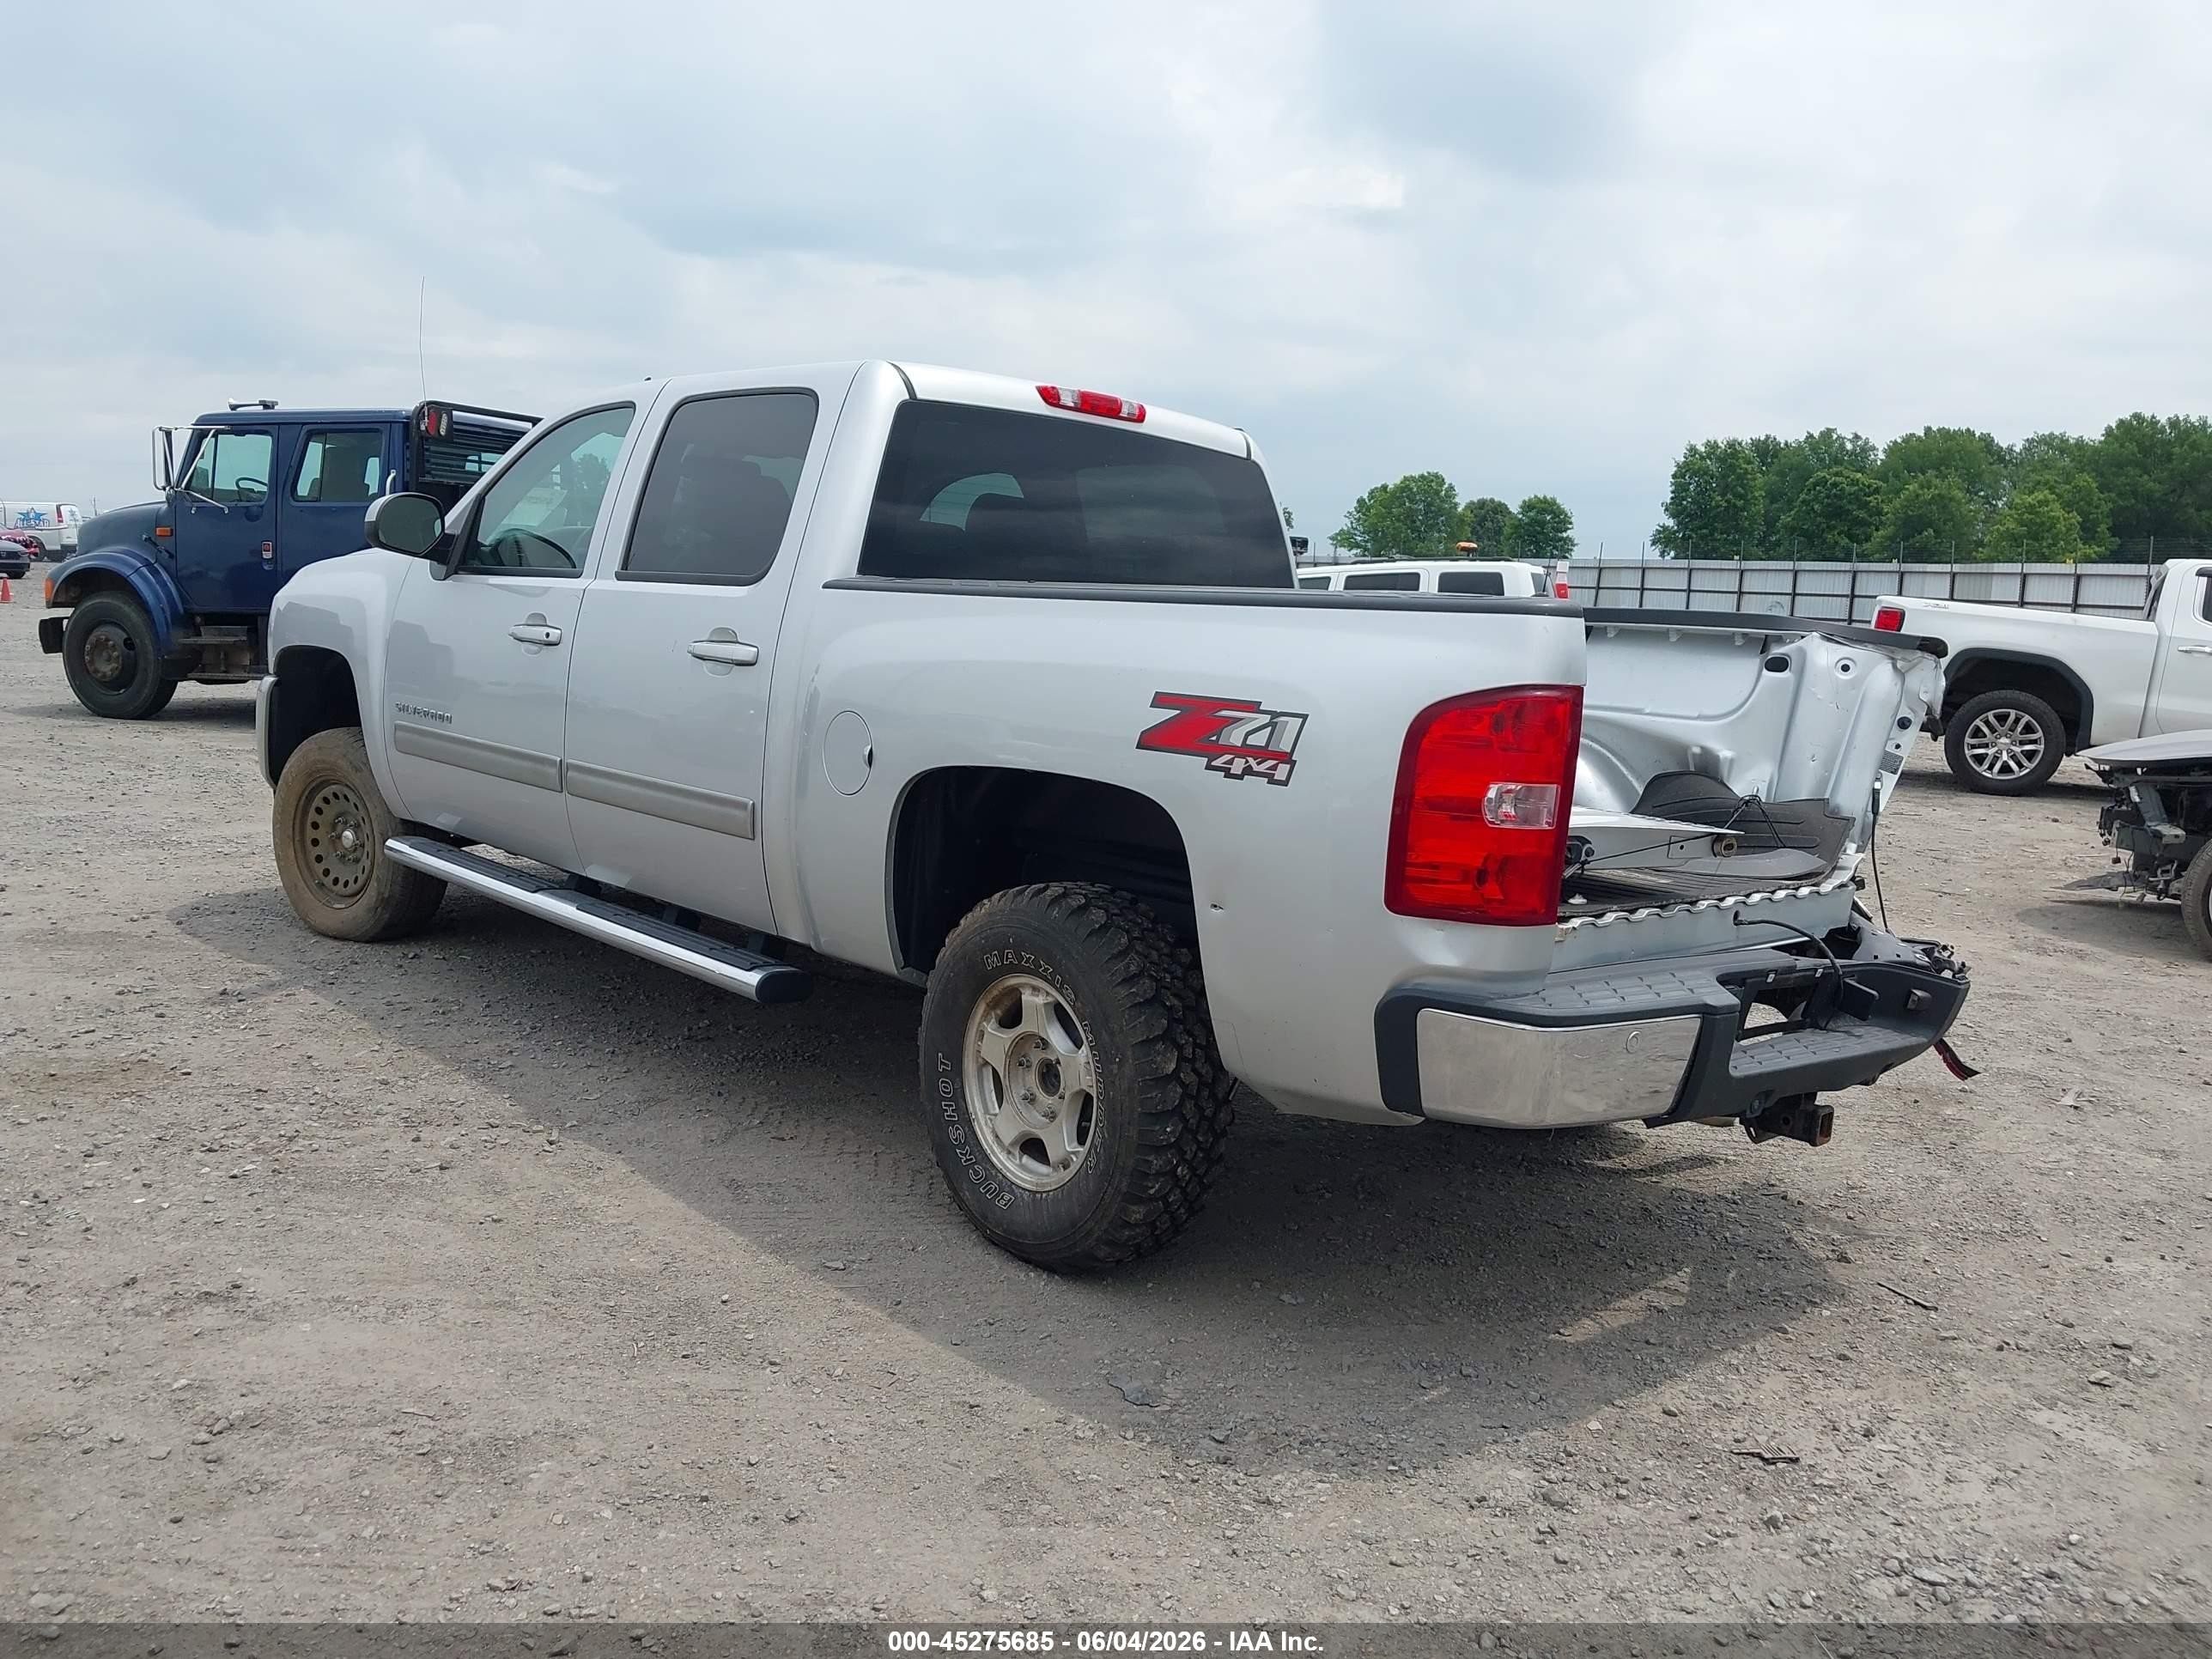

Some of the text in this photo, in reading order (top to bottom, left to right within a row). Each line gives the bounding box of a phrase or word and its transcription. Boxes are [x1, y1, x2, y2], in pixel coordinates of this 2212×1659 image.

[1135, 692, 1310, 761] Z71
[983, 949, 1076, 1006] MAXXIS
[938, 1052, 1016, 1210] BUCKSHOT
